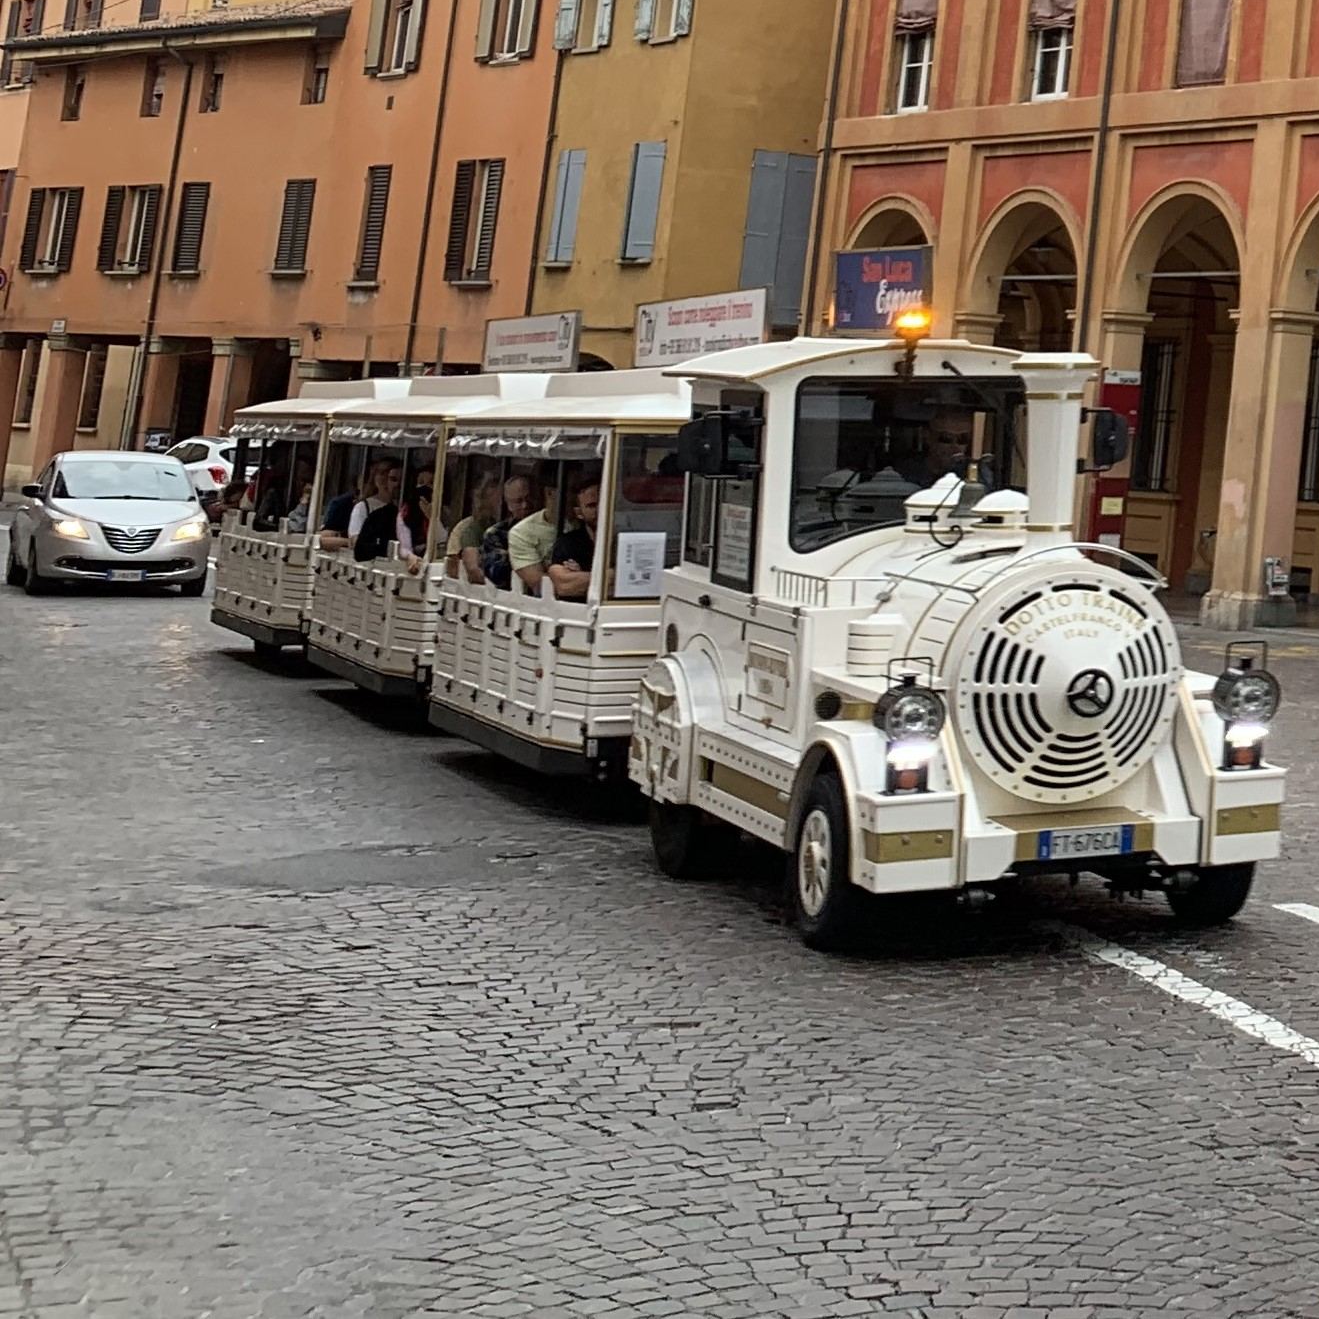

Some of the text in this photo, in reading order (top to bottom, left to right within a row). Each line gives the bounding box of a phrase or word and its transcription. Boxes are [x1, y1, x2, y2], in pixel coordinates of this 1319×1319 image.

[862, 255, 912, 283] San Luca
[1004, 593, 1072, 636] DOTTO
